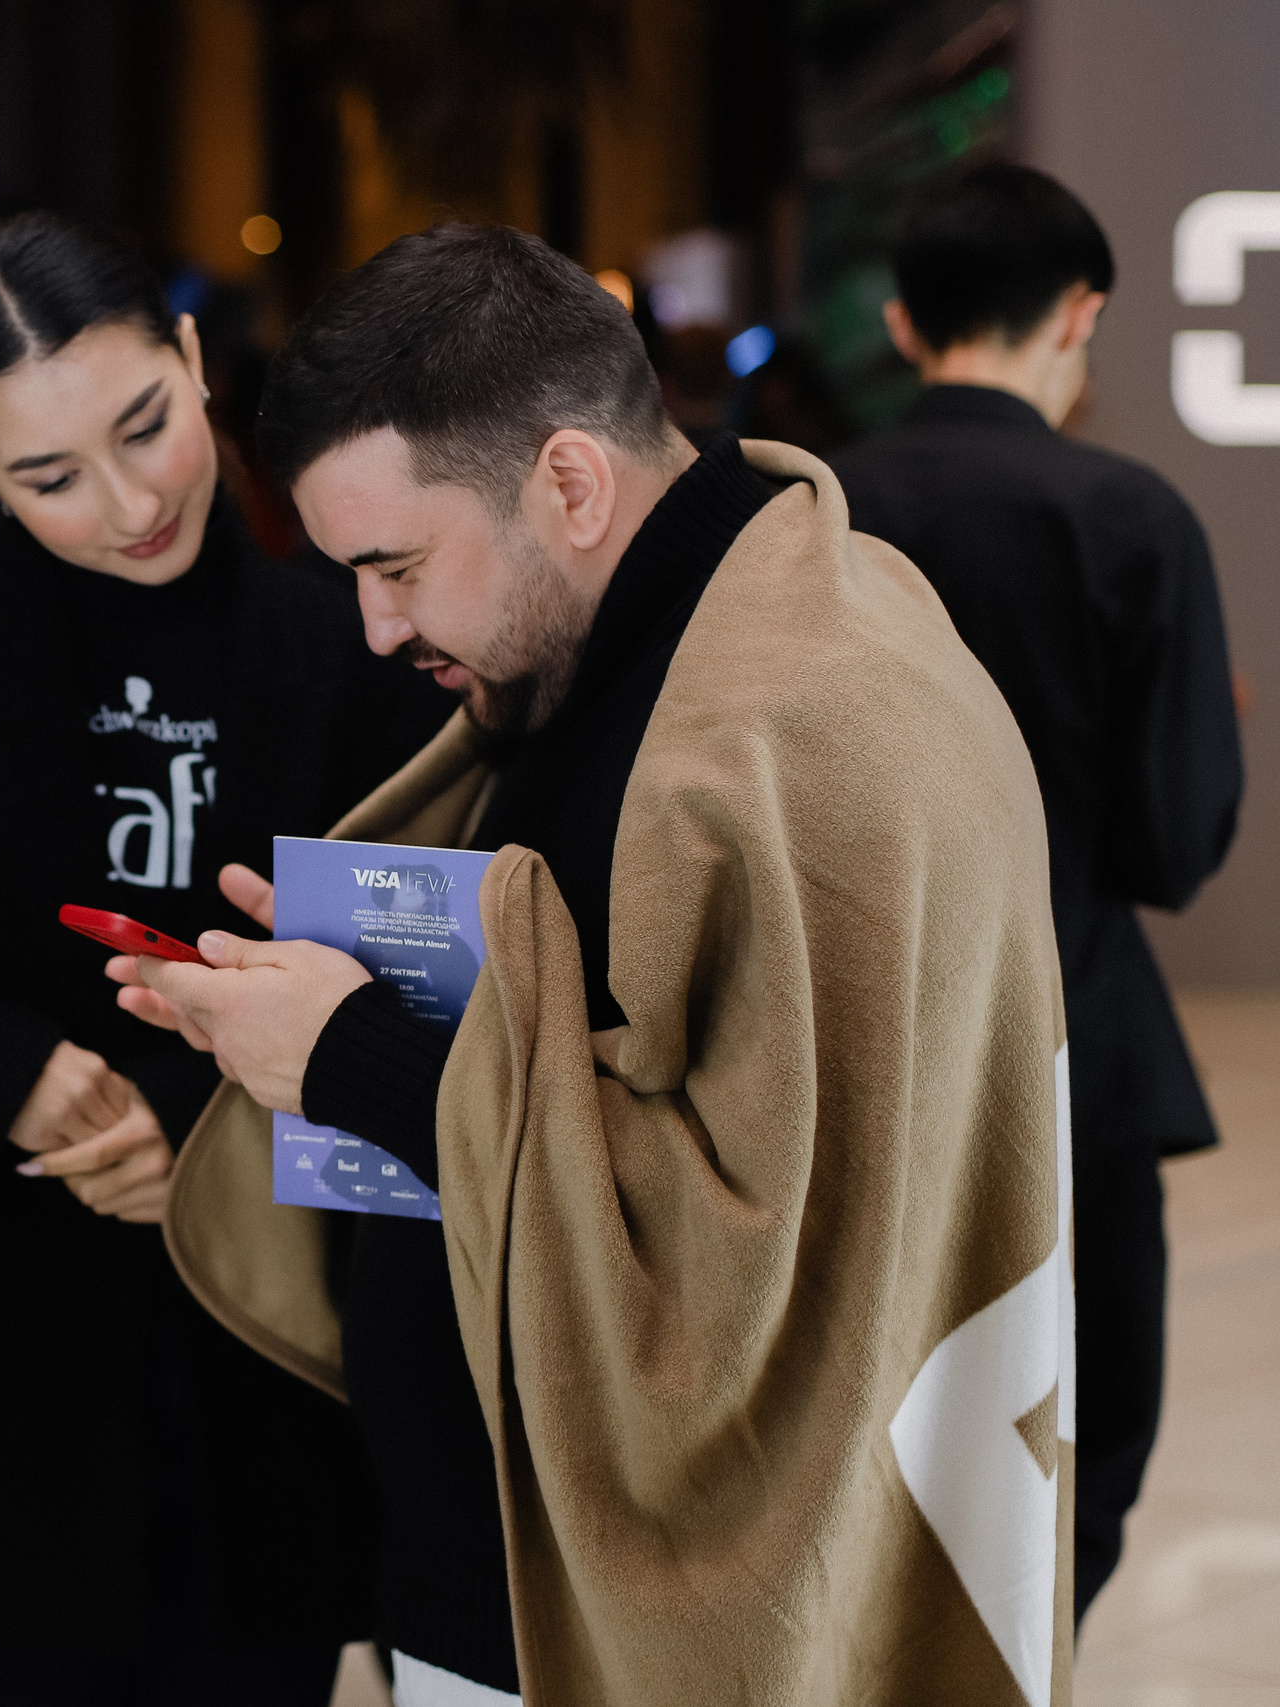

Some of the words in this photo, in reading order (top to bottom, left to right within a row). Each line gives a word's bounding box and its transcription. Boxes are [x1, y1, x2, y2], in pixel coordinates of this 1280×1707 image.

[350, 868, 400, 889] VISA
[396, 911, 434, 920] ПРИГЛАСИТЬ
[403, 920, 460, 930] МЕЖДУНАРОДНОЙ
[413, 928, 450, 936] КАЗАХСТАНЕ
[377, 936, 403, 945] Fashion
[426, 940, 451, 950] Almaty
[390, 968, 426, 978] ОКТЯБРЯ
